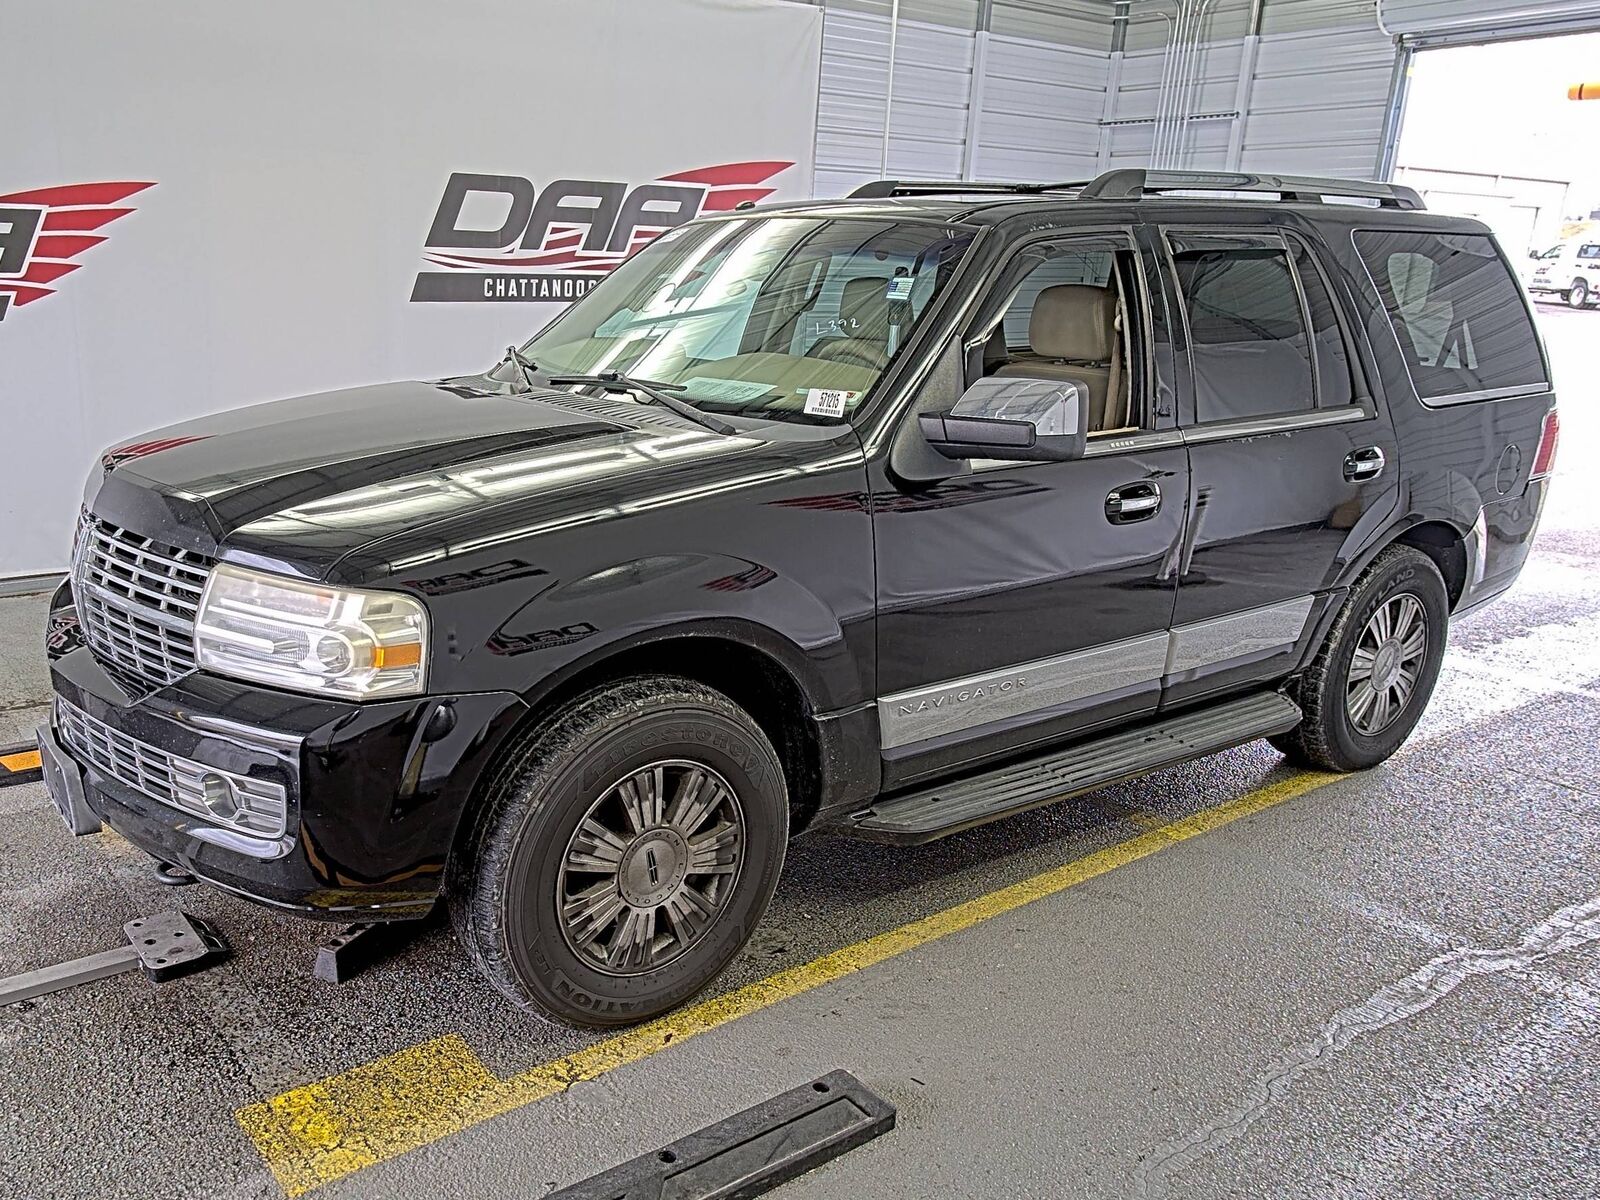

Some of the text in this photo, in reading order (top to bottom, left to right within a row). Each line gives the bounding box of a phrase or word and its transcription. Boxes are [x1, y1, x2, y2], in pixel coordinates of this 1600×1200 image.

[424, 172, 707, 253] DAA
[818, 392, 841, 409] 571215
[899, 677, 1027, 716] NAVIGATOR
